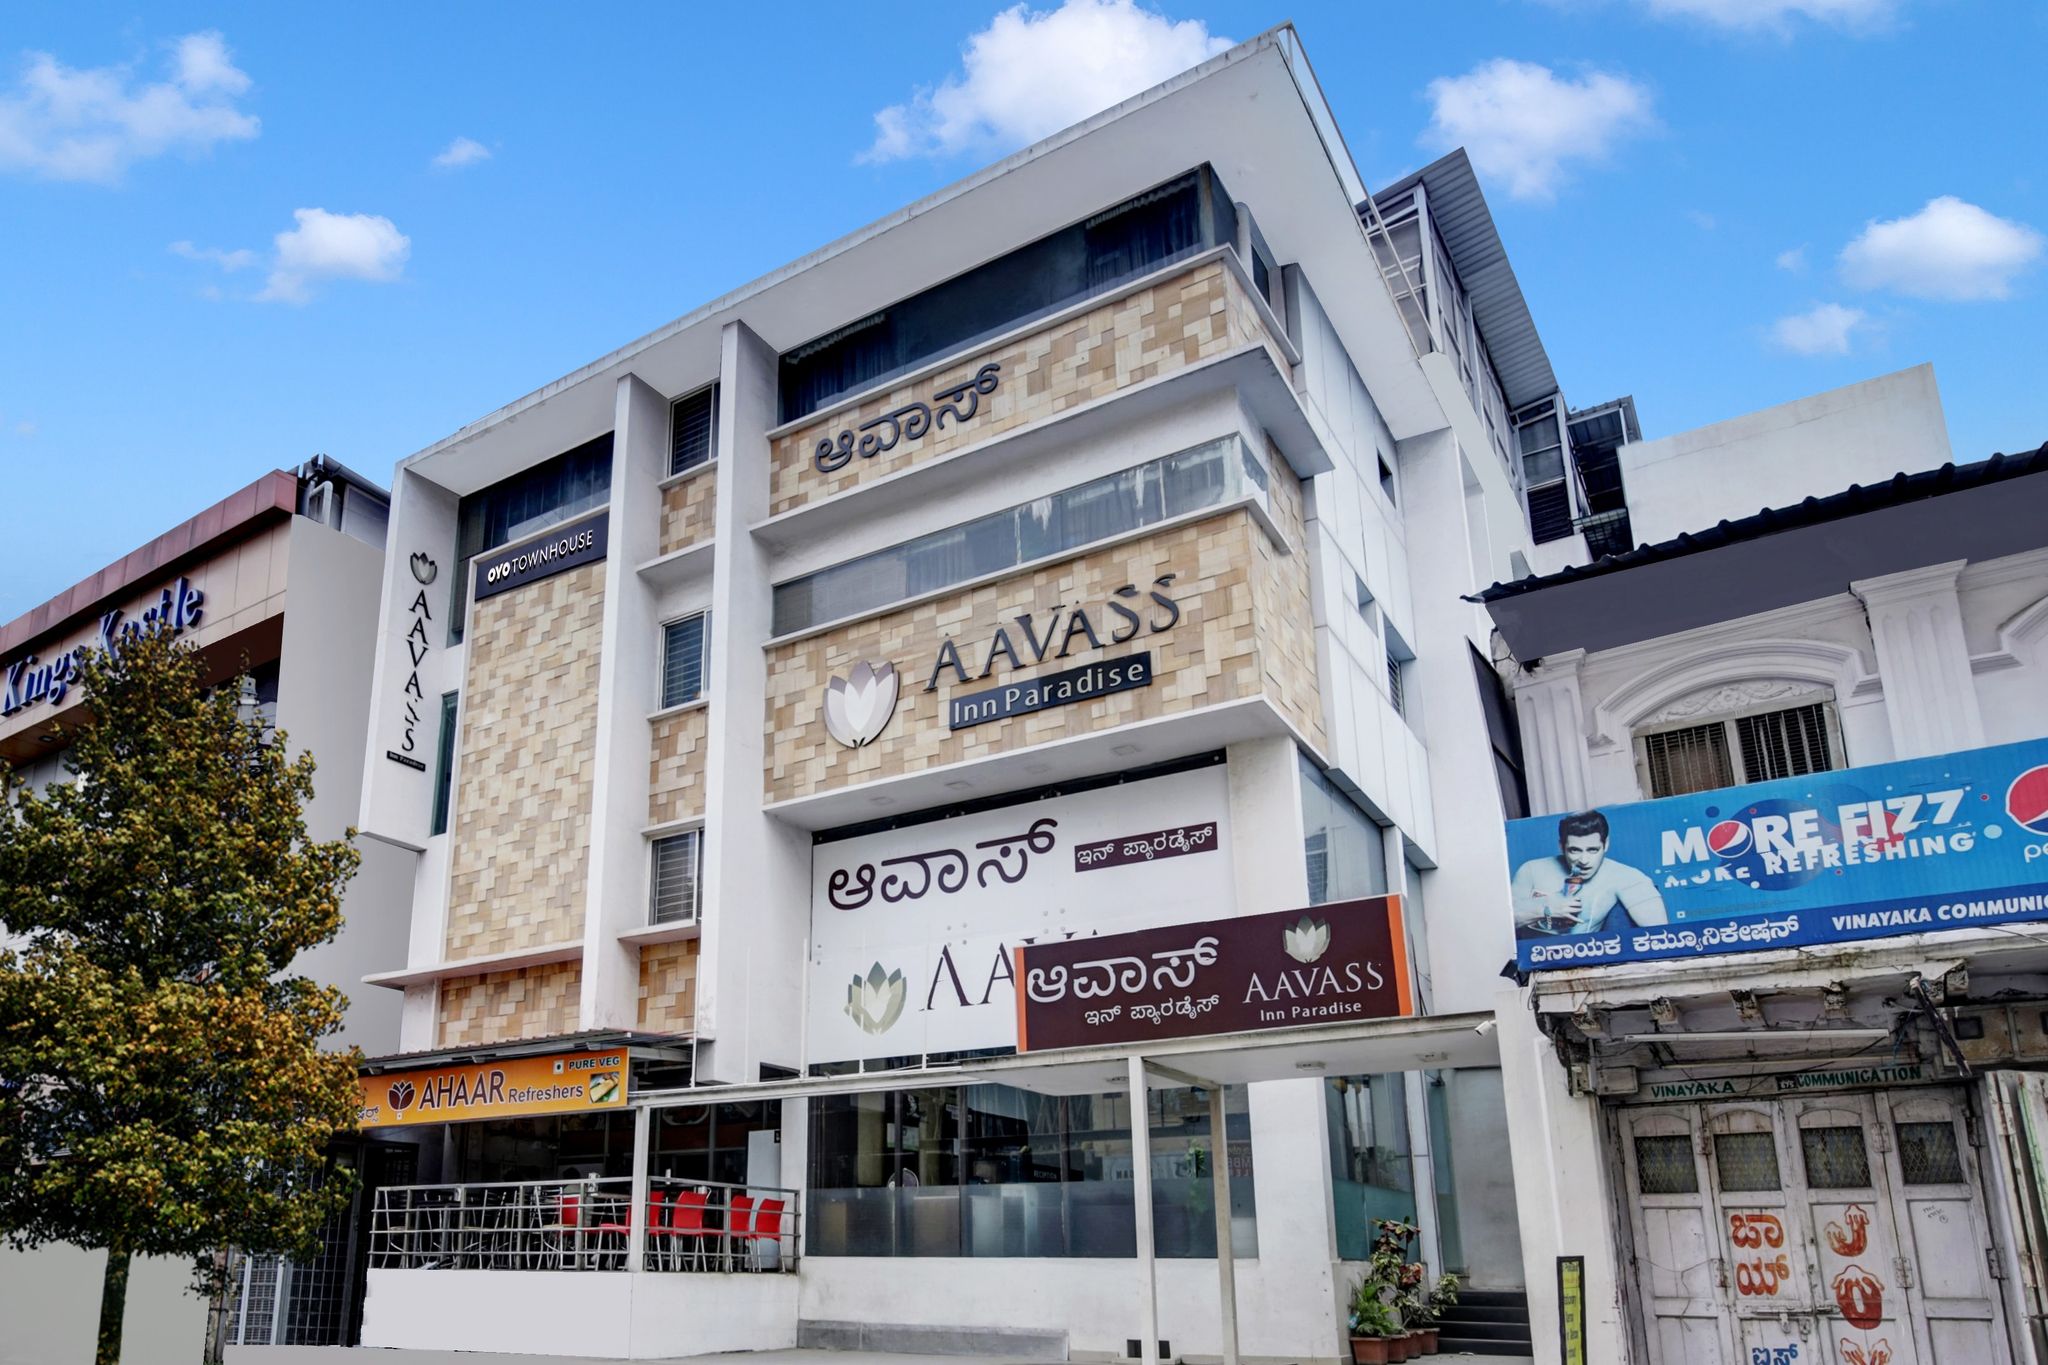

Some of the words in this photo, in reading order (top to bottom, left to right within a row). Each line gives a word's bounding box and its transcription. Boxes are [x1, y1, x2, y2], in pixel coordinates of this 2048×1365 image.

[815, 363, 1000, 472] ಆವಾಸ್
[487, 561, 511, 582] OYO
[511, 530, 593, 573] TOWNHOUSE
[923, 574, 1179, 692] AAVASS
[1, 645, 86, 717] Kings
[401, 589, 432, 751] AAVASS
[954, 697, 997, 723] Inn
[1005, 662, 1144, 712] Paradise
[1838, 788, 1965, 845] FIZZ
[828, 818, 1058, 911] ಆವಾಸ್
[1762, 831, 1977, 876] REFRESHING
[1832, 906, 1932, 931] VINAYAKA
[1027, 937, 1219, 1003] ಆವಾಸ್
[1530, 934, 1621, 963] ವಿನಾಯಕ
[1242, 961, 1384, 1004] AAVASS
[1260, 1009, 1285, 1022] Inn
[1292, 1002, 1362, 1019] Paradise
[568, 1058, 596, 1070] PURE
[598, 1056, 620, 1067] VEG
[1652, 1080, 1737, 1098] VINAYAKA
[1798, 1065, 1922, 1087] COMMUNICATION
[418, 1070, 506, 1111] AHAAR
[508, 1084, 584, 1105] Refreshers
